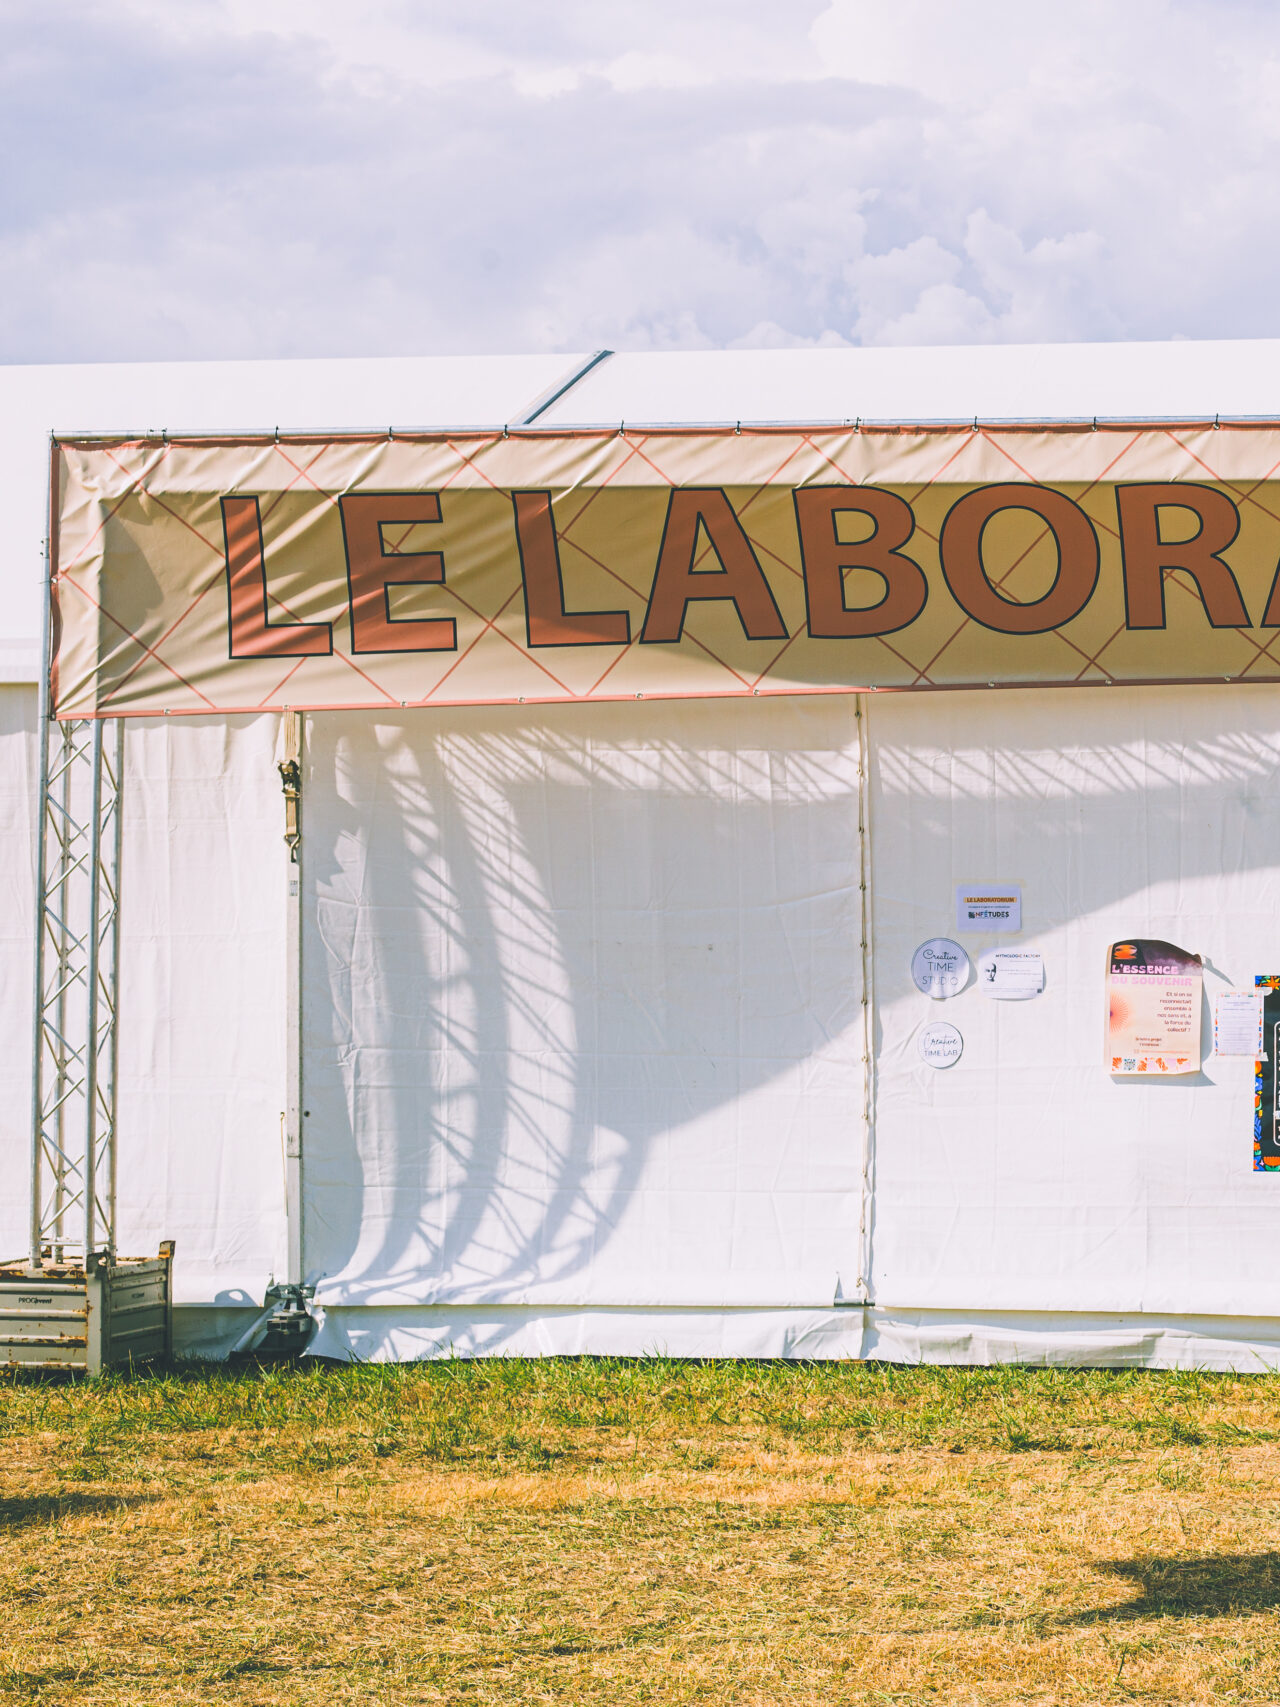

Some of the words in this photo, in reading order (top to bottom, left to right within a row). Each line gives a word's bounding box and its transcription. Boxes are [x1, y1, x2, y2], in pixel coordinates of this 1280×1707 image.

[220, 492, 458, 659] LE
[923, 949, 958, 960] Creative
[928, 961, 954, 972] TIME
[1111, 964, 1179, 975] L'ESSENCE
[922, 976, 959, 986] STUDIO
[1111, 976, 1128, 985] DU
[1132, 976, 1192, 987] SOUVENIR
